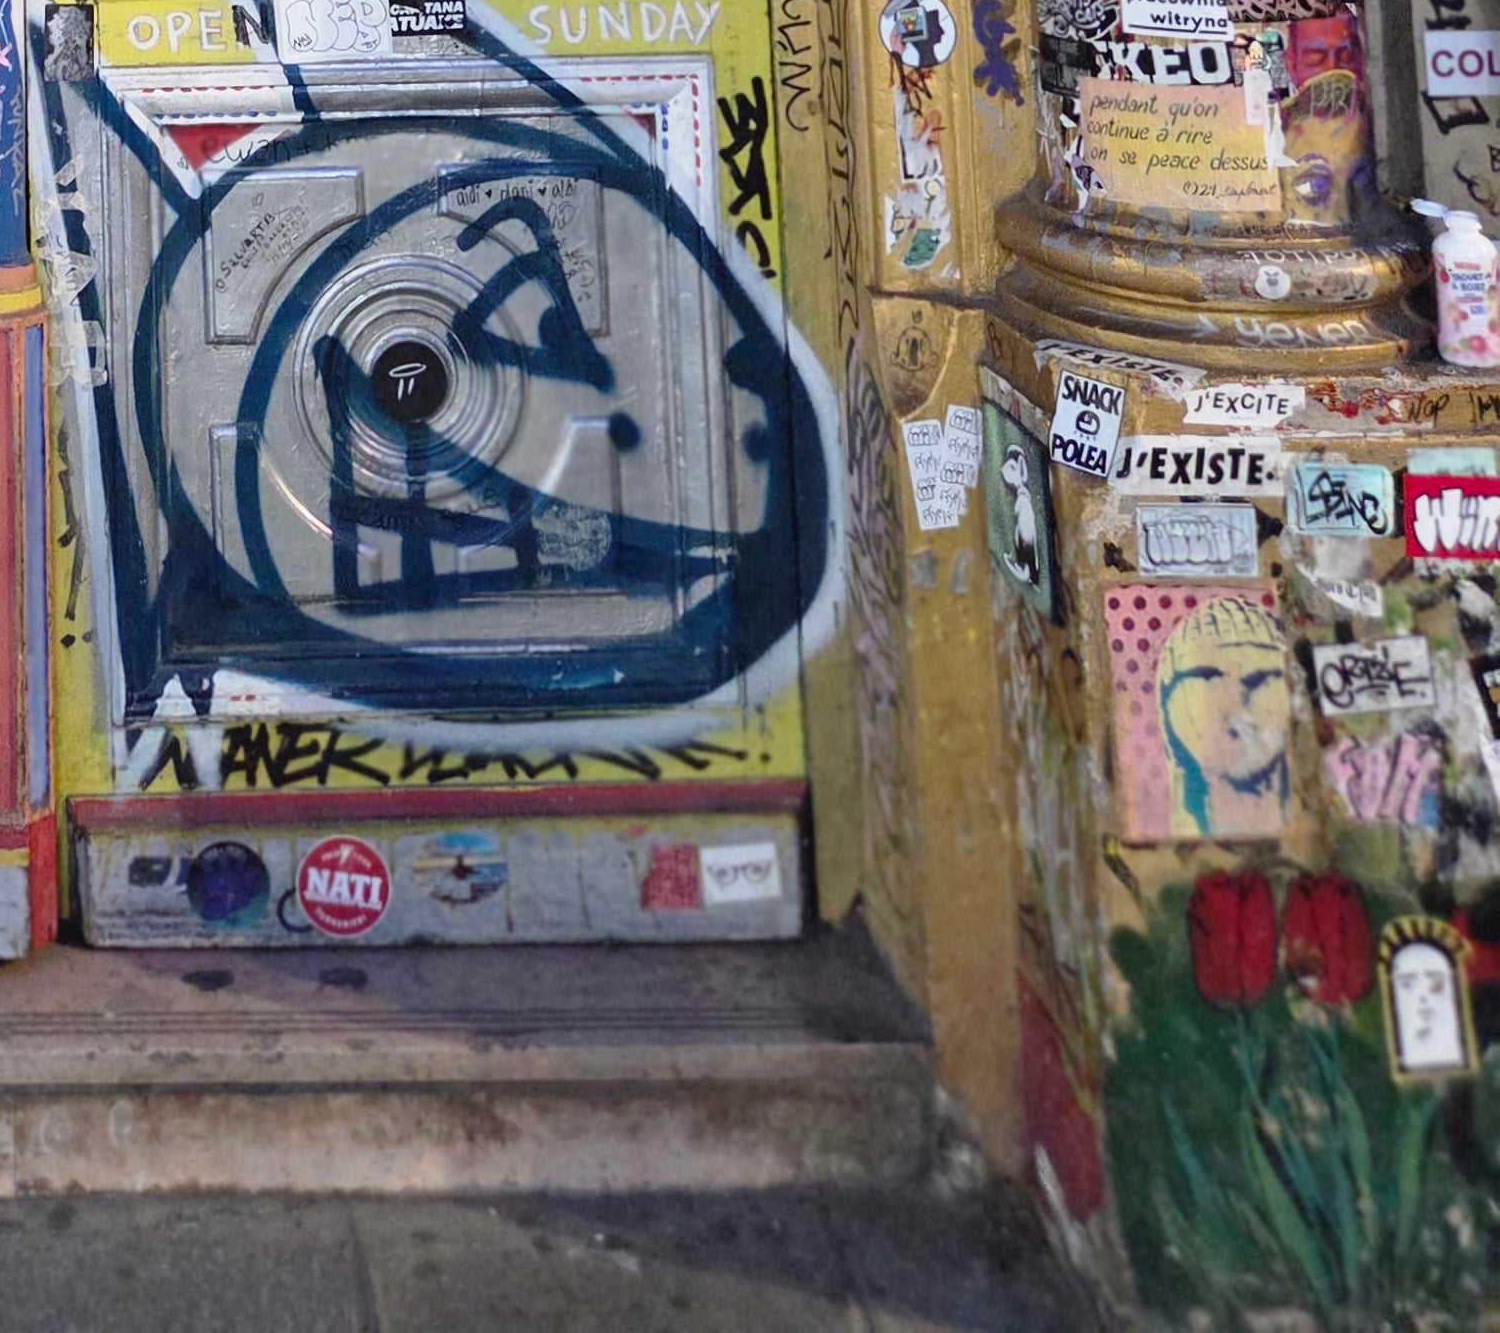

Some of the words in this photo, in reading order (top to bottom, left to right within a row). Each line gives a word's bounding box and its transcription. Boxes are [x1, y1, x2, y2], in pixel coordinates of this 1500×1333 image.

[128, 3, 273, 51] OPEN
[529, 1, 723, 51] SUNDAY
[1150, 11, 1228, 31] witryna
[1089, 97, 1158, 118] pendant
[1169, 97, 1219, 125] qu'on
[1087, 121, 1150, 142] continue
[1156, 123, 1169, 142] à
[1175, 127, 1213, 145] rire
[1090, 146, 1108, 160] on
[1119, 151, 1137, 165] se
[1146, 150, 1201, 174] peace
[1211, 149, 1269, 171] dessus
[1062, 374, 1121, 415] SNACK
[1193, 391, 1289, 416] J'EXCITE
[1051, 433, 1107, 477] POLEA
[1119, 446, 1276, 487] J'EXISTE.
[303, 866, 384, 911] NATI
